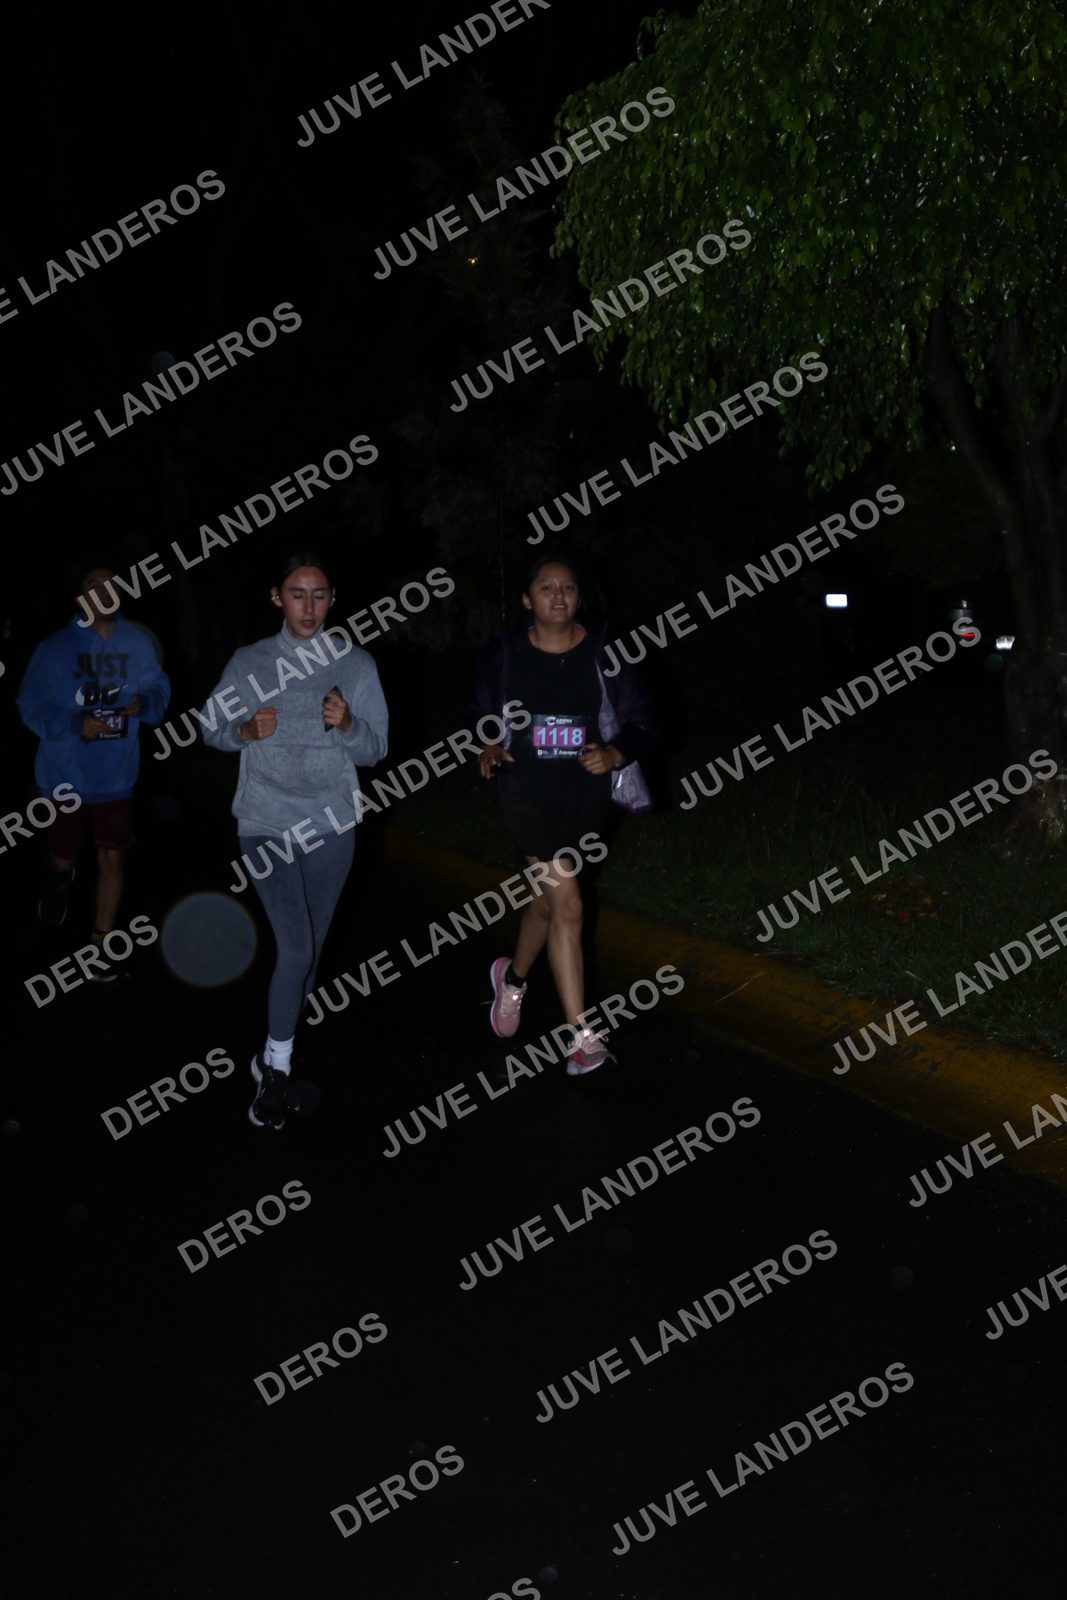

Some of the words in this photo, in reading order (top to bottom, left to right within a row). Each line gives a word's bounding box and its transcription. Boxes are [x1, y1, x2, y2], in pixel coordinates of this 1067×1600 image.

[74, 653, 129, 678] JUST
[84, 681, 118, 705] DO
[537, 727, 583, 745] 1118
